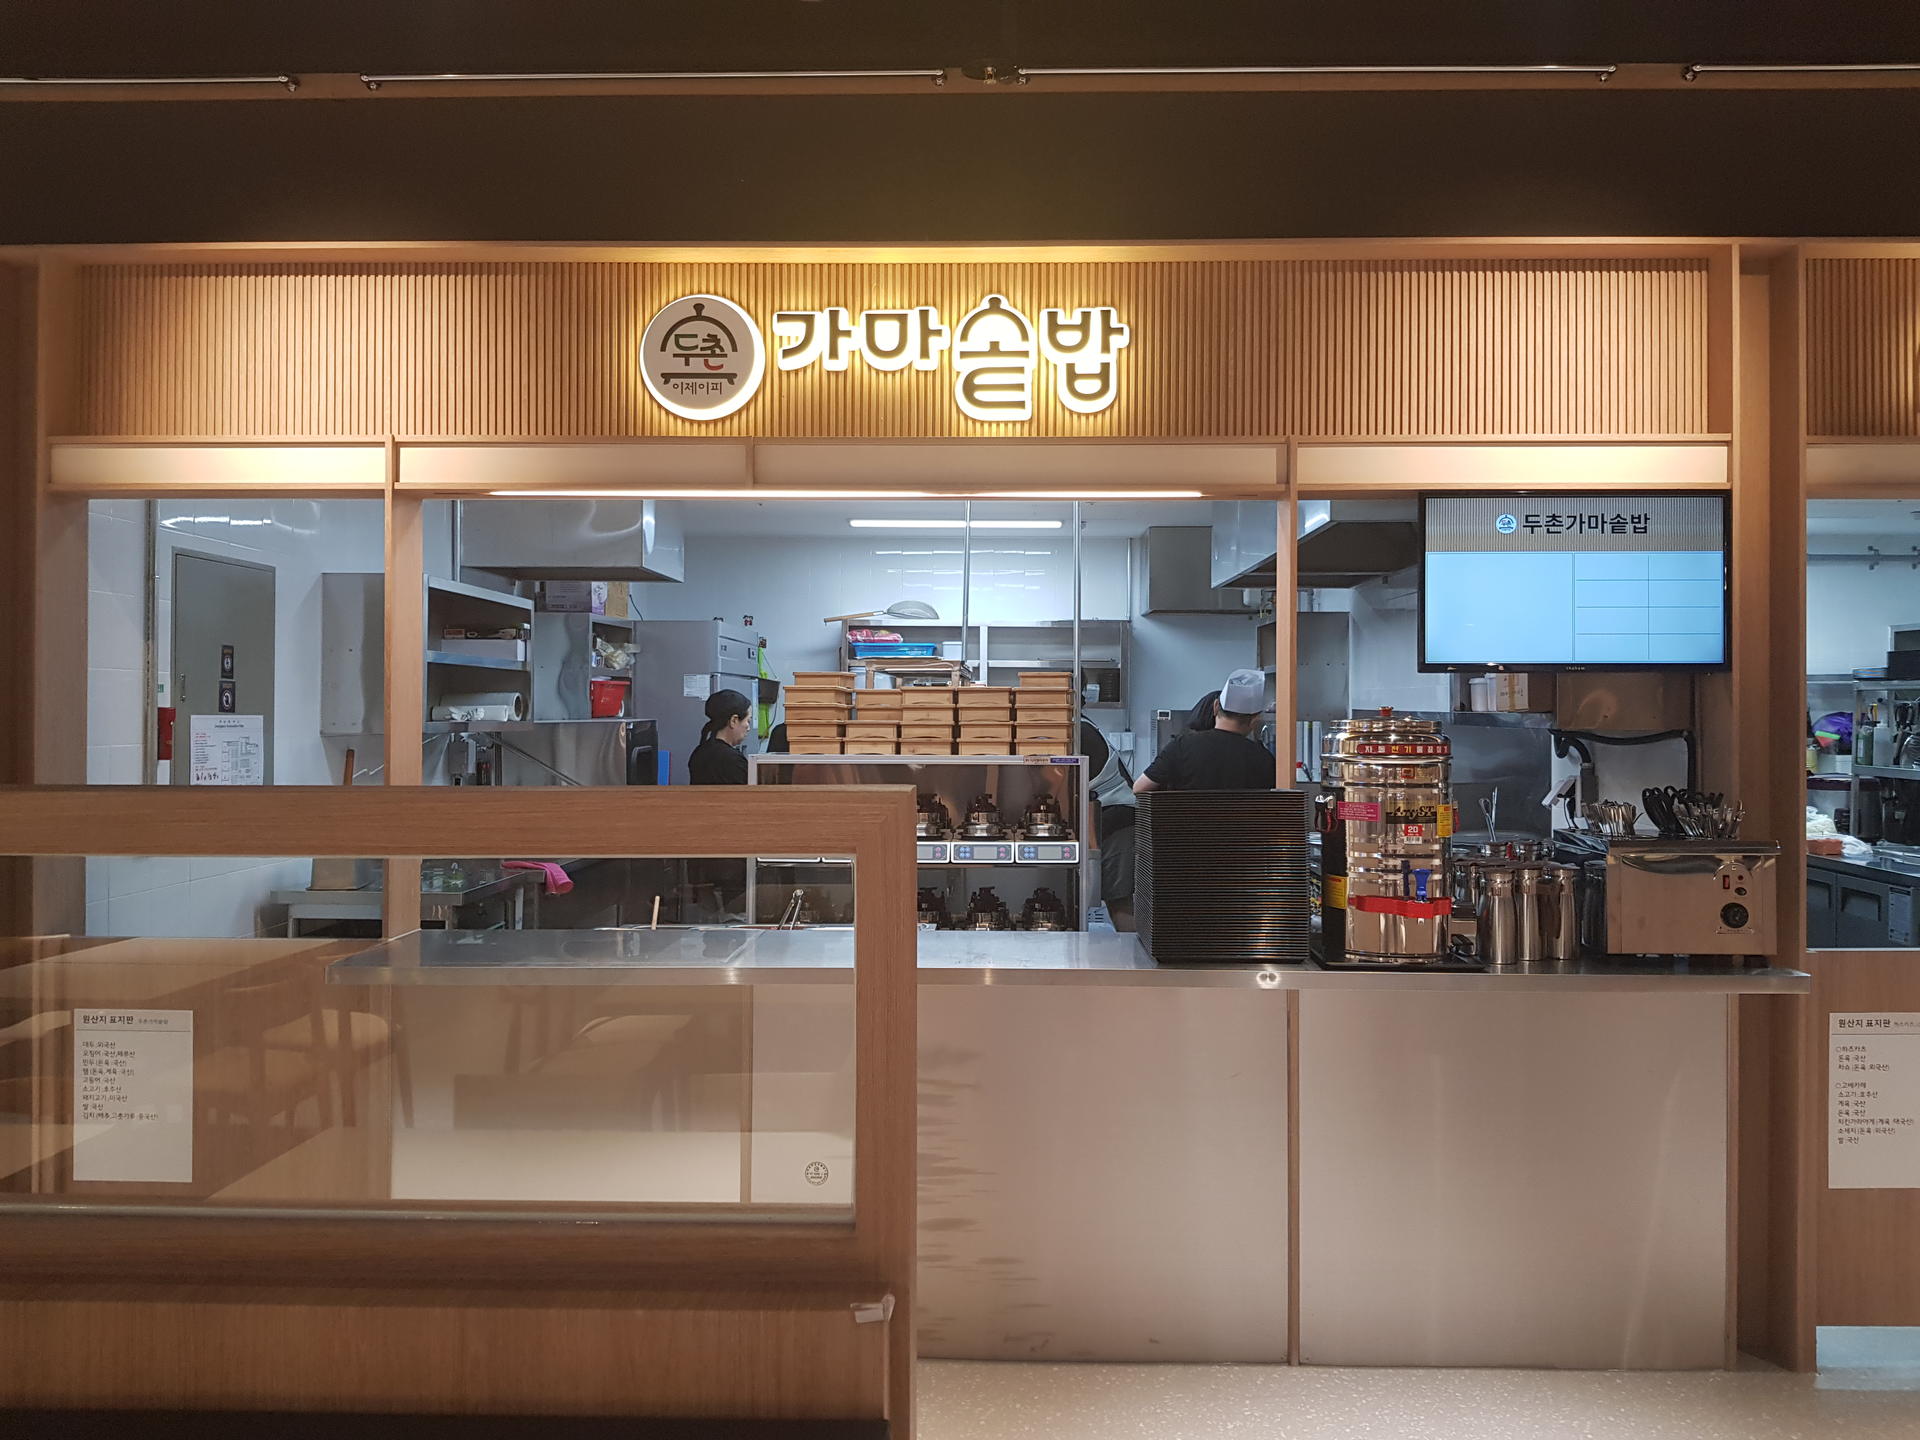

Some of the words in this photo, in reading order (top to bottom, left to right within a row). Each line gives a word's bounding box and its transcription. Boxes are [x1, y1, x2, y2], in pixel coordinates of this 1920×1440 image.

[673, 333, 728, 371] 두촌
[774, 296, 1127, 413] 가마솥밥
[672, 381, 722, 395] 이제이피
[1522, 513, 1651, 534] 두촌가마솥밥
[1407, 825, 1419, 833] 20
[82, 1015, 107, 1025] 원산지
[1838, 1019, 1863, 1028] 원산지
[1865, 1019, 1891, 1028] 표지판
